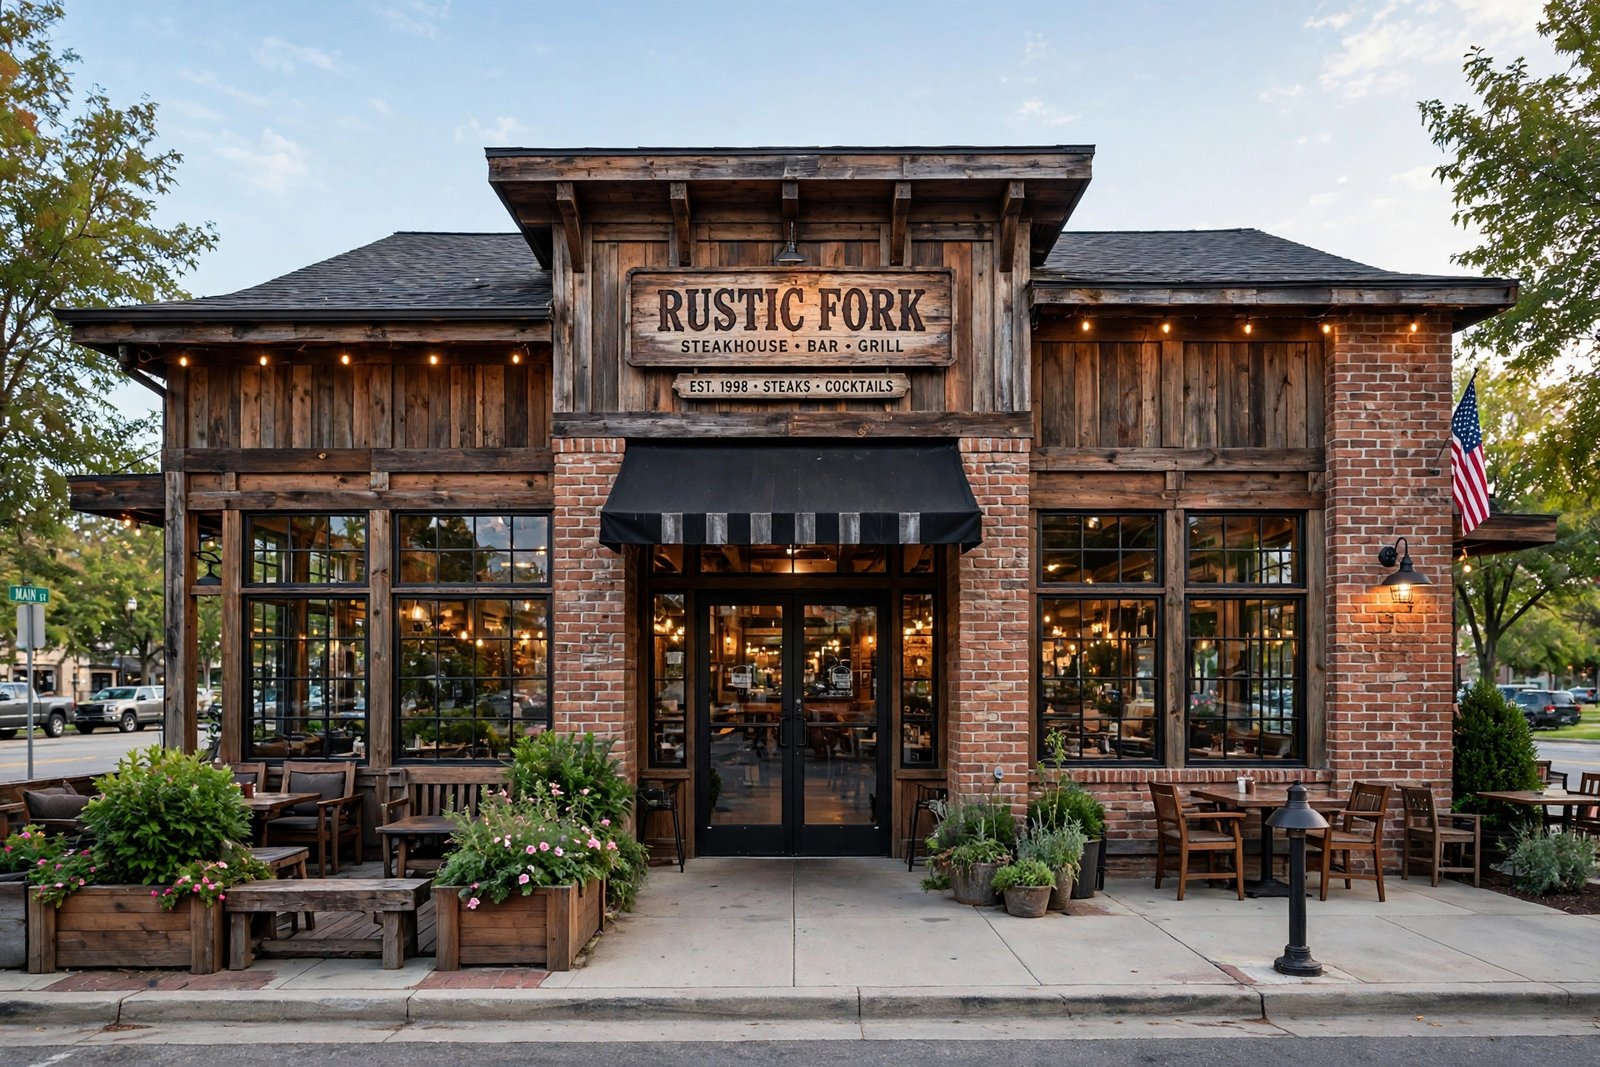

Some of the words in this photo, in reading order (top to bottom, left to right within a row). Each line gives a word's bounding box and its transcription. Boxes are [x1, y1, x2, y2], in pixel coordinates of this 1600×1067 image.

[657, 287, 804, 332] RUSTIC
[818, 287, 926, 332] FORK
[681, 339, 788, 353] STEAKHOUSE
[807, 339, 839, 353] BAR
[858, 339, 904, 353] GRILL
[690, 380, 715, 393] EST.
[720, 380, 748, 393] 1998
[763, 380, 811, 393] STEAKS
[825, 380, 894, 393] COCKTAILS
[15, 588, 37, 601] MAIN
